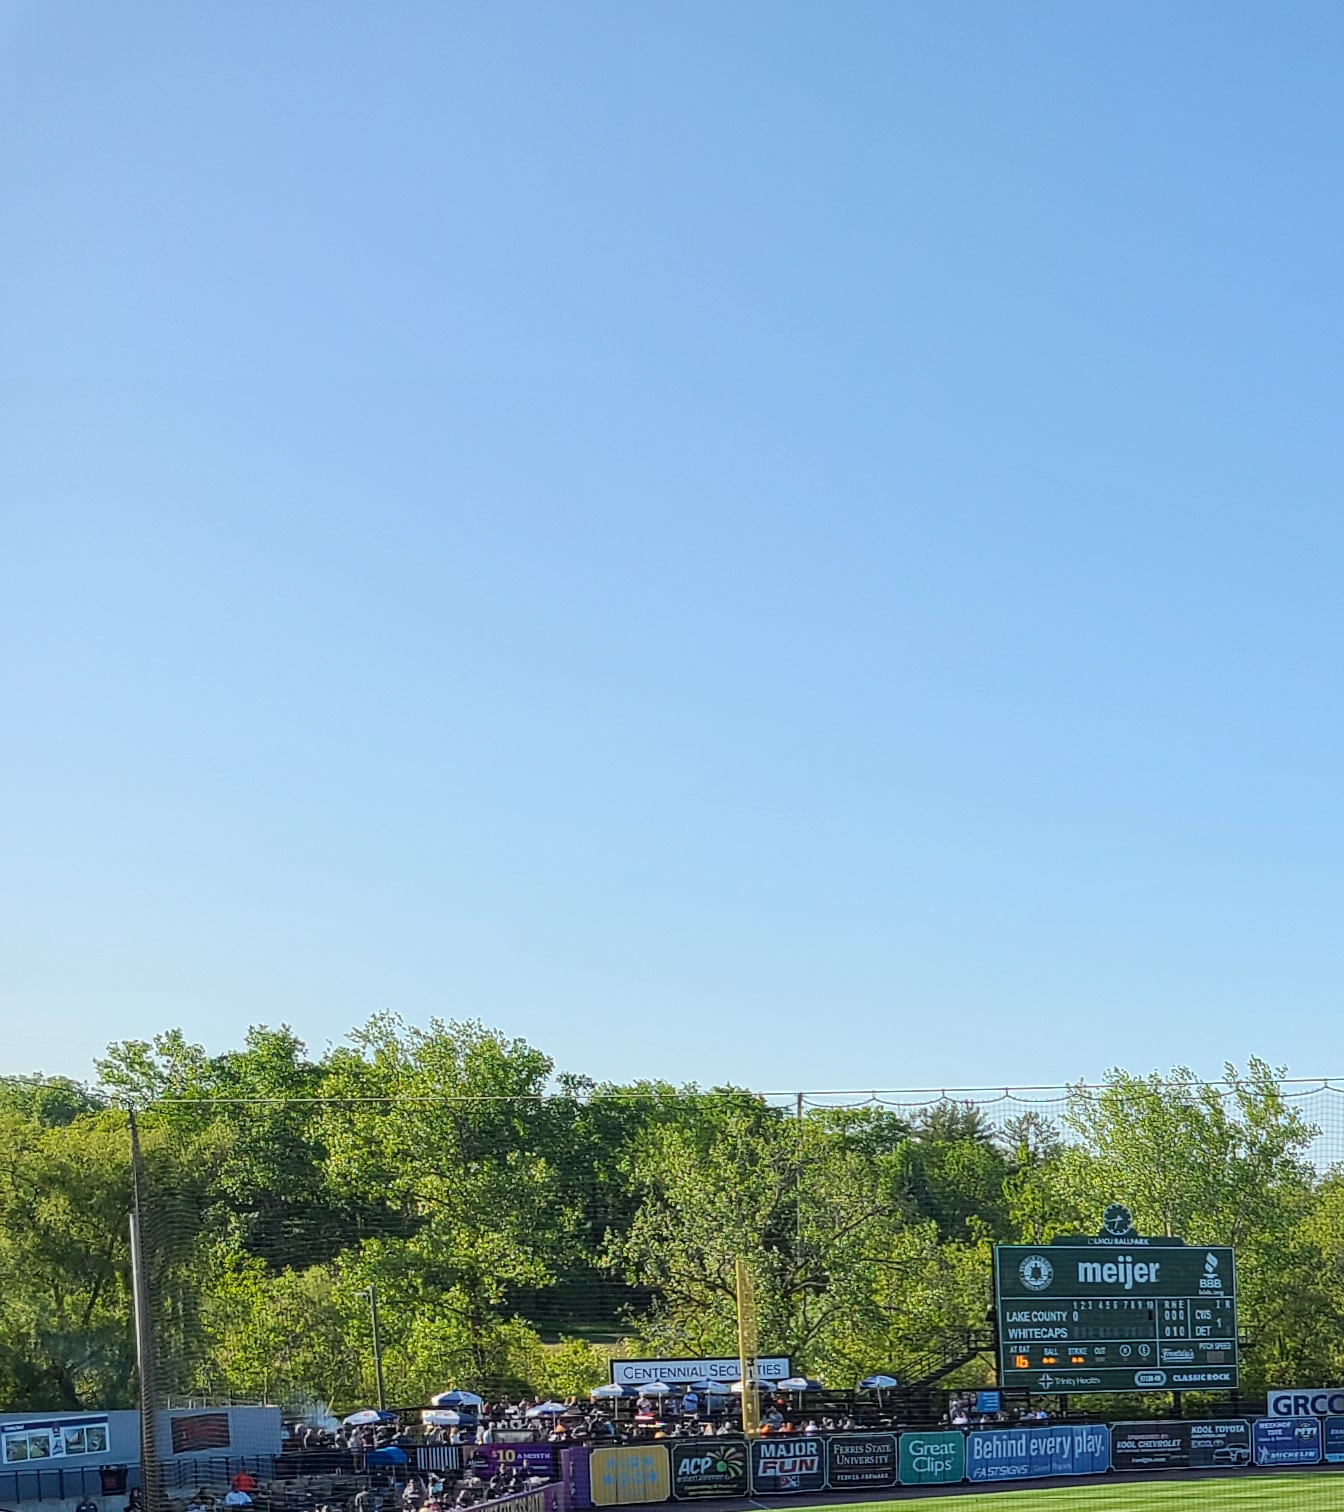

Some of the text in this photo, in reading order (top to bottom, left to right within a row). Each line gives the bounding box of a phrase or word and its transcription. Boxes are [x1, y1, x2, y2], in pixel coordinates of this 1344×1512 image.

[1078, 1256, 1160, 1290] meijer
[1200, 1279, 1222, 1289] BBB
[1006, 1311, 1031, 1322] LAKE
[1032, 1310, 1067, 1322] COUNTY
[1008, 1328, 1068, 1339] WHITECAPS
[1195, 1327, 1212, 1336] DET
[623, 1365, 706, 1380] CENTENNIAL
[1172, 1374, 1206, 1382] CLASSIC
[1206, 1373, 1230, 1382] ROCK
[1054, 1377, 1076, 1386] Trinity
[1191, 1425, 1245, 1434] KOOL TOYOTA
[760, 1442, 817, 1458] MAJOR
[834, 1443, 892, 1455] FERRIS STATE
[909, 1440, 956, 1456] Great
[973, 1430, 1105, 1460] Behind every play.
[1116, 1440, 1137, 1449] KOOL
[1137, 1439, 1181, 1448] CHEVROLET
[836, 1455, 888, 1465] UNIVERSITY
[1270, 1451, 1316, 1459] MICHELIN
[678, 1457, 712, 1475] ACP
[761, 1459, 817, 1475] FUN
[912, 1457, 952, 1476] Clips
[973, 1465, 1028, 1478] FASTSIGNS
